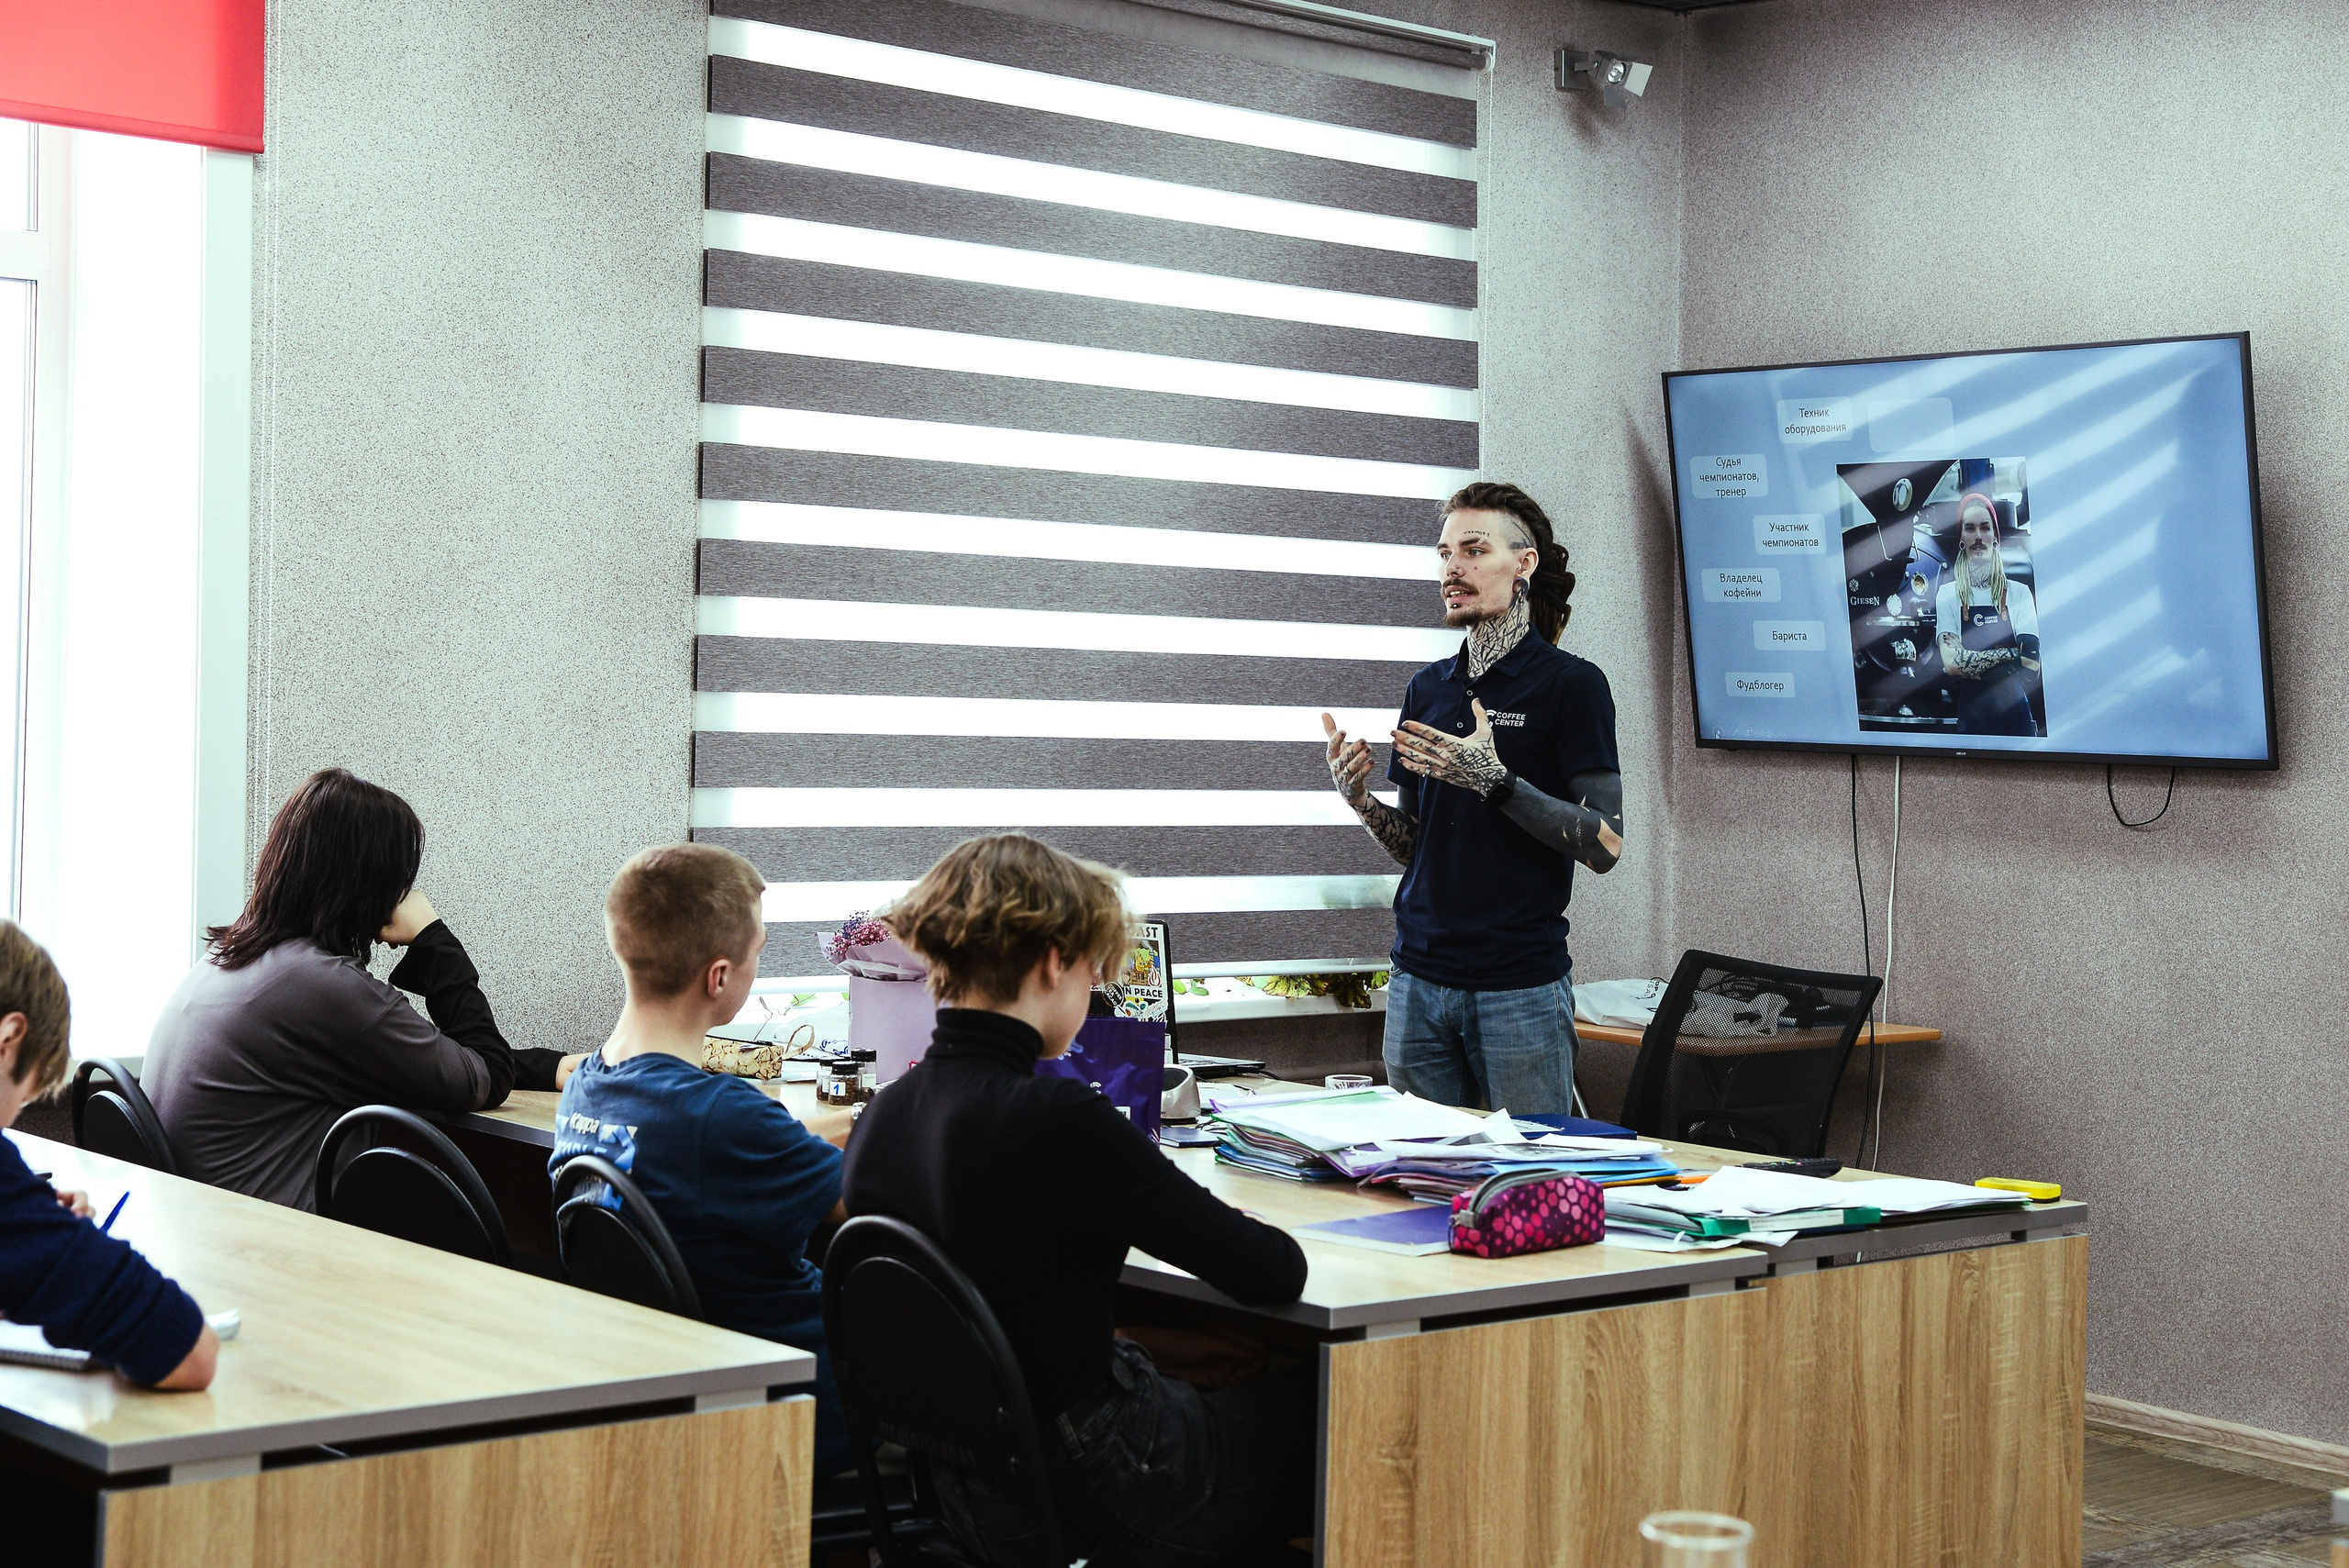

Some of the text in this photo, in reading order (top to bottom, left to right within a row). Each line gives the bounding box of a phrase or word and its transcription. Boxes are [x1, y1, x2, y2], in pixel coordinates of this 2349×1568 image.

[1798, 407, 1830, 418] Техник
[1785, 423, 1847, 436] оборудования
[1715, 457, 1742, 469] Судья
[1699, 472, 1760, 483] чемпионатов,
[1716, 487, 1747, 498] тренер
[1769, 522, 1809, 532] Участник
[1762, 538, 1820, 548] чемпионатов
[1720, 573, 1763, 584] Владелец
[1723, 587, 1762, 599] кофейни
[1772, 630, 1807, 642] Бариста
[1736, 679, 1785, 693] Фудблогер
[1497, 711, 1526, 720] COFFEE
[1495, 718, 1524, 728] CENTER
[1134, 987, 1163, 998] PEACE
[833, 1084, 840, 1095] 1
[569, 1112, 601, 1135] Kappa
